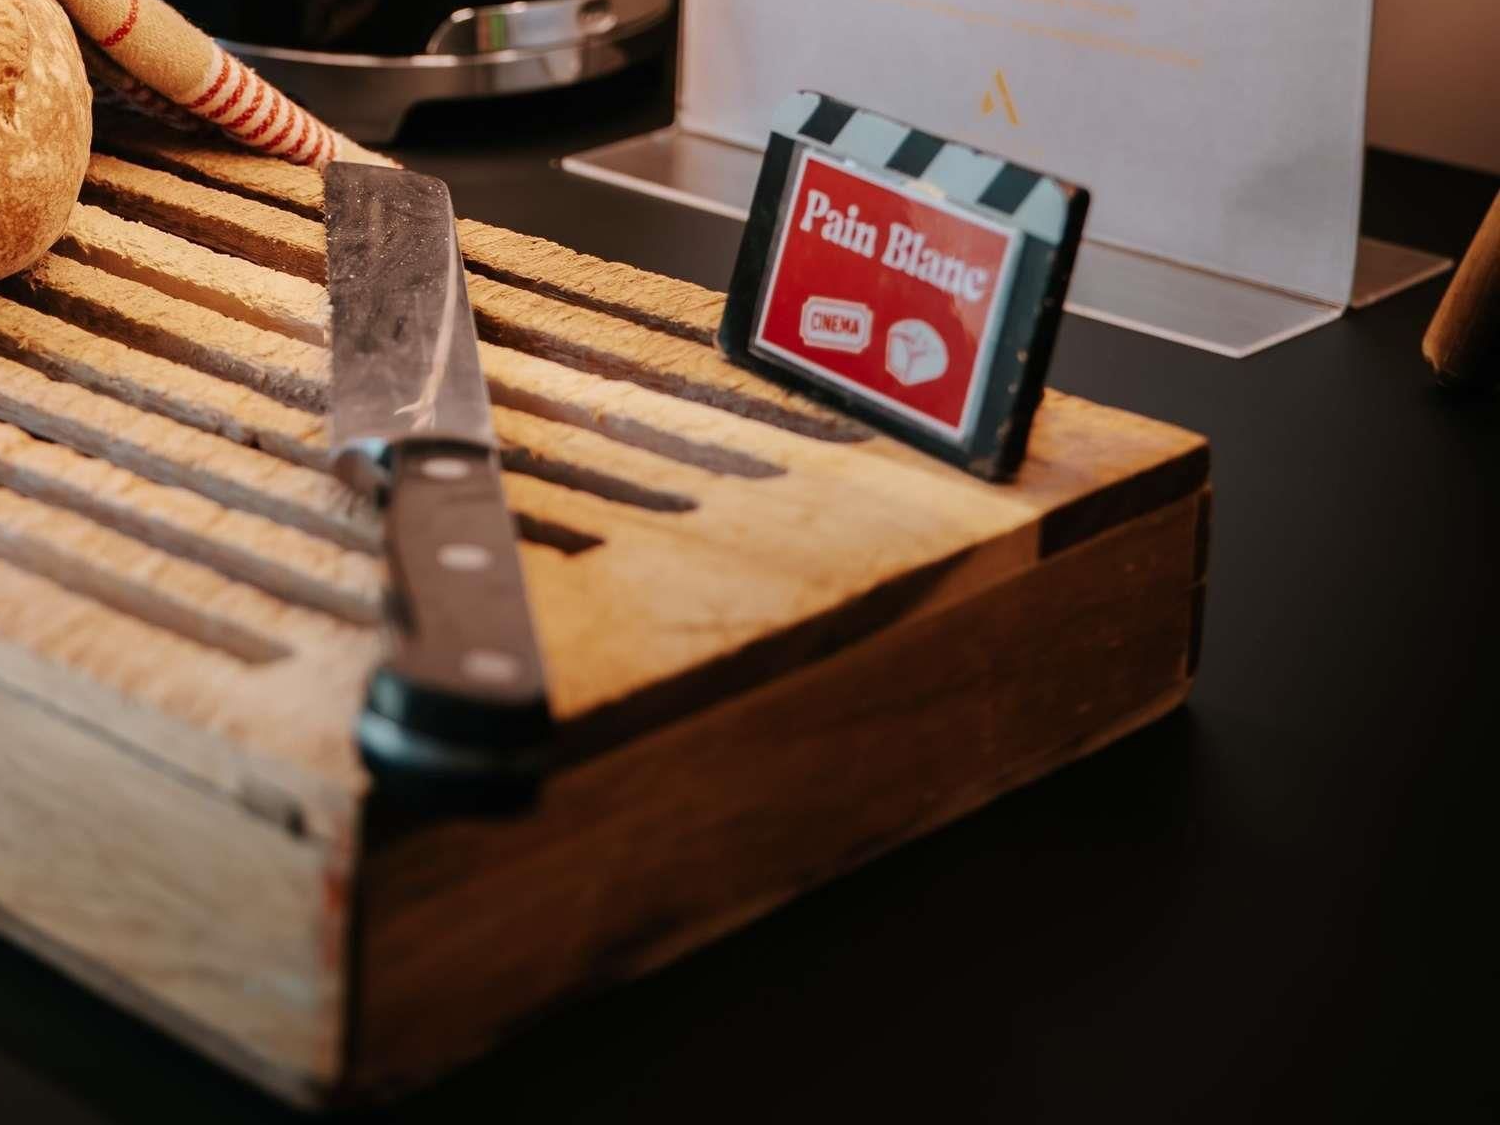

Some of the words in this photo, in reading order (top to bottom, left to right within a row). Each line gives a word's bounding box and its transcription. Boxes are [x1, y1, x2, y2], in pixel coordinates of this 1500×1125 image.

[799, 188, 879, 260] Pain
[880, 222, 989, 304] Blanc
[811, 312, 860, 337] CINEMA
